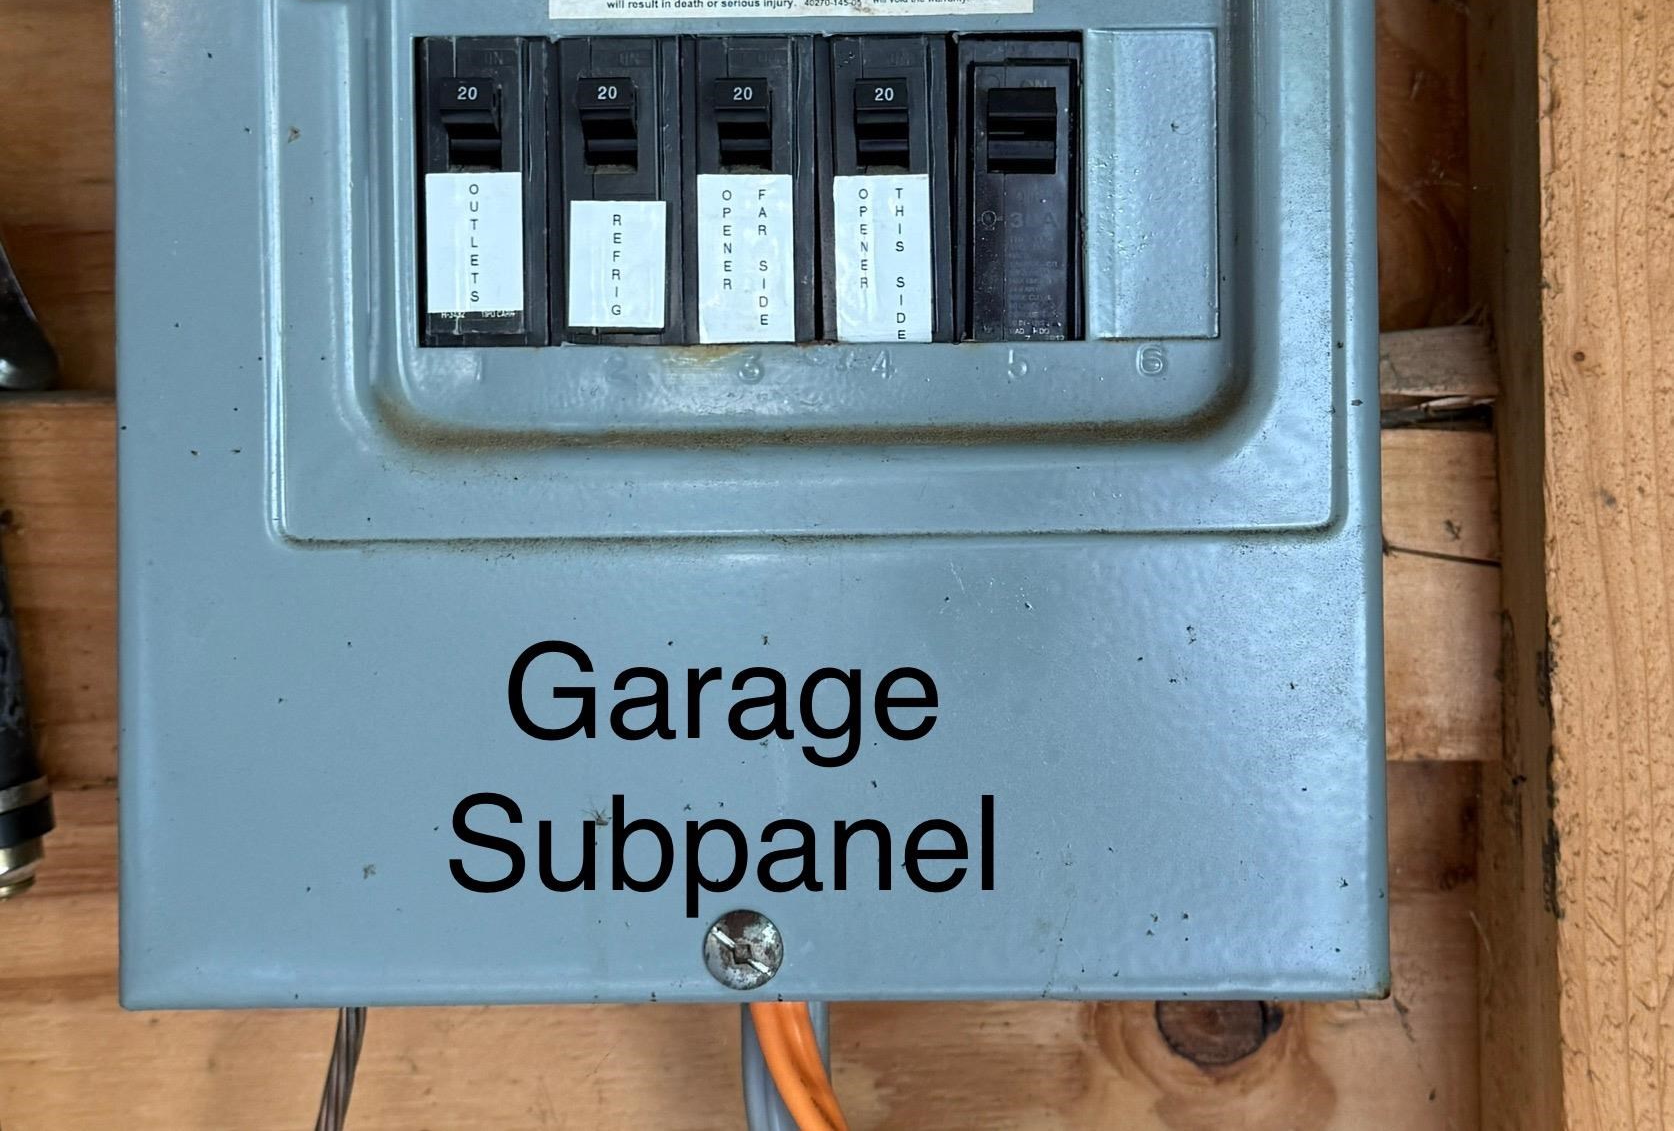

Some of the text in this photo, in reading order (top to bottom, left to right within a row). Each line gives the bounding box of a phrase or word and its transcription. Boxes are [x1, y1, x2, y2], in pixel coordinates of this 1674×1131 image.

[705, 0, 719, 8] or
[458, 87, 477, 99] 20
[598, 86, 617, 99] 20
[734, 87, 752, 100] 20
[875, 88, 893, 100] 20
[468, 183, 480, 303] OUTLETS
[611, 214, 622, 316] REFRIG
[721, 189, 732, 290] OPENER
[758, 188, 769, 326] FAR SIDE
[858, 188, 869, 288] OPENER
[895, 187, 906, 340] THIS SIDE
[1135, 344, 1166, 376] 6
